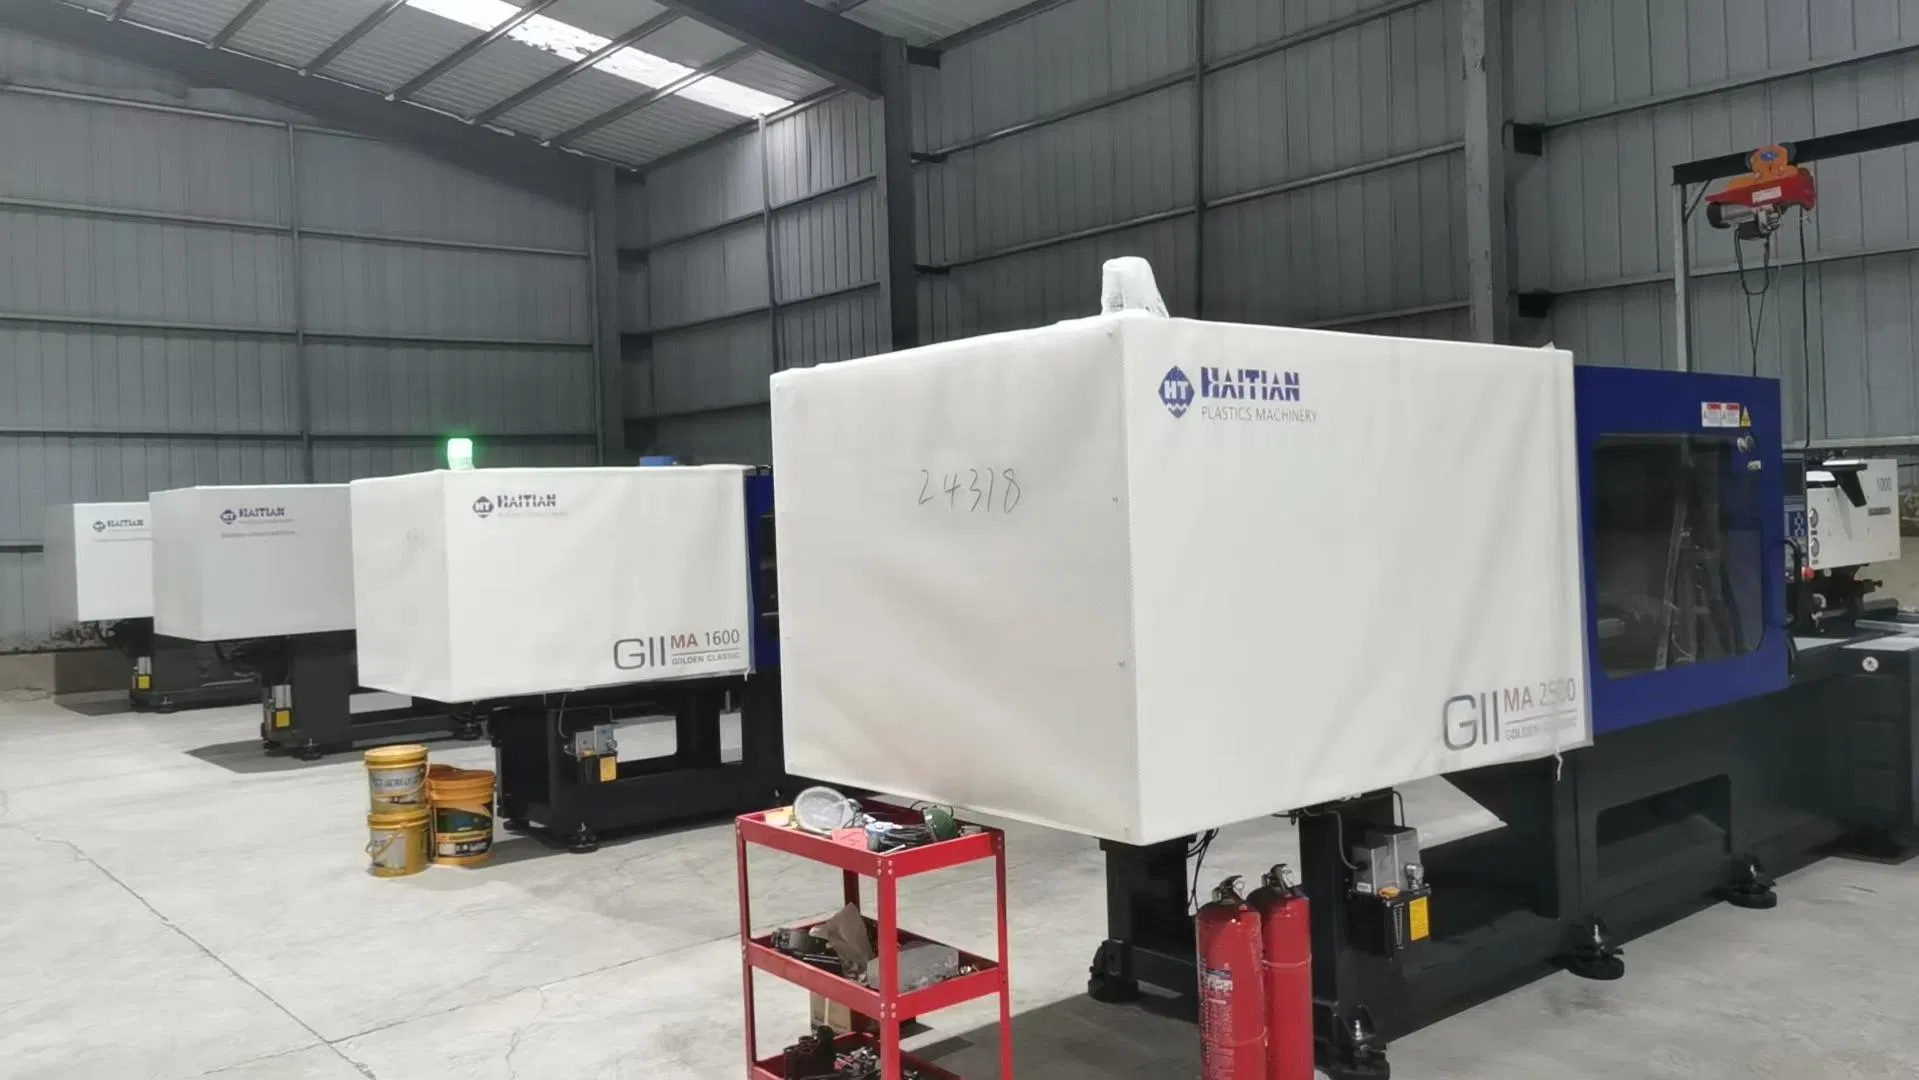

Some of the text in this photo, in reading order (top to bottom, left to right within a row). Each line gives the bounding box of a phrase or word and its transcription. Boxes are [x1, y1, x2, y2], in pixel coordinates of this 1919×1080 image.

[1201, 366, 1301, 402] HAITIAN
[1201, 406, 1317, 423] PLASTICS MACHINERY
[917, 467, 1022, 514] 24318
[497, 494, 556, 508] HAITIAN
[671, 629, 740, 649] MA 1600
[671, 655, 704, 665] GOLDEN
[1503, 685, 1533, 713] MA
